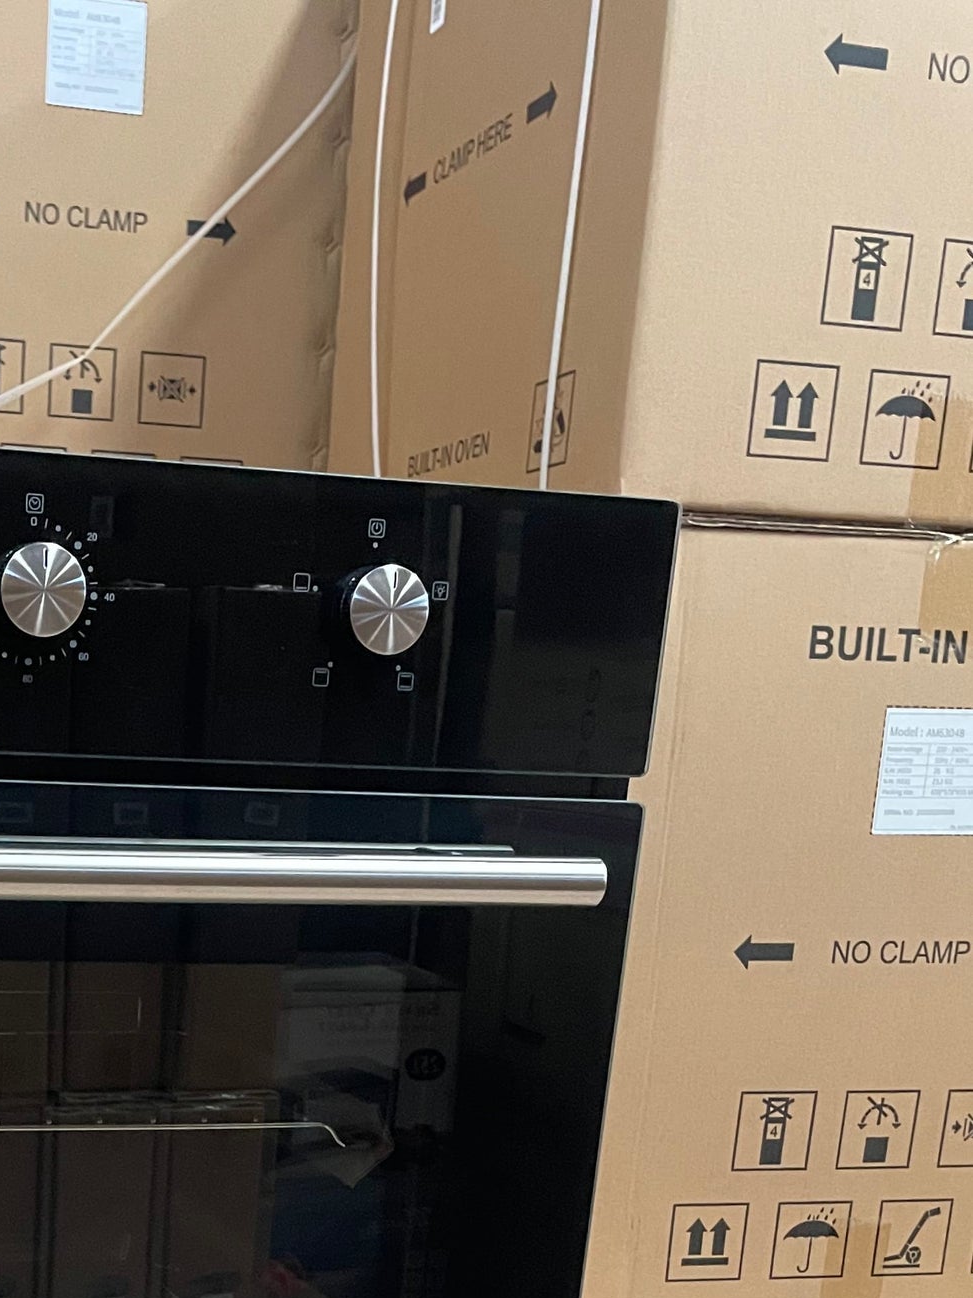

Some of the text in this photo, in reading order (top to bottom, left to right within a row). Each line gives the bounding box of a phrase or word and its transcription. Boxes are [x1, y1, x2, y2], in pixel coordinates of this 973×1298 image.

[927, 52, 971, 84] NO
[433, 113, 513, 184] CLAMP HERE
[24, 200, 148, 234] NO CLAMP
[862, 272, 871, 287] 4
[407, 431, 491, 478] BUILT-IN OVEN
[86, 532, 98, 542] 20
[103, 592, 116, 602] 40
[808, 624, 969, 665] BUILT-IN
[831, 940, 971, 965] NO CLAMP
[769, 1125, 778, 1138] 4
